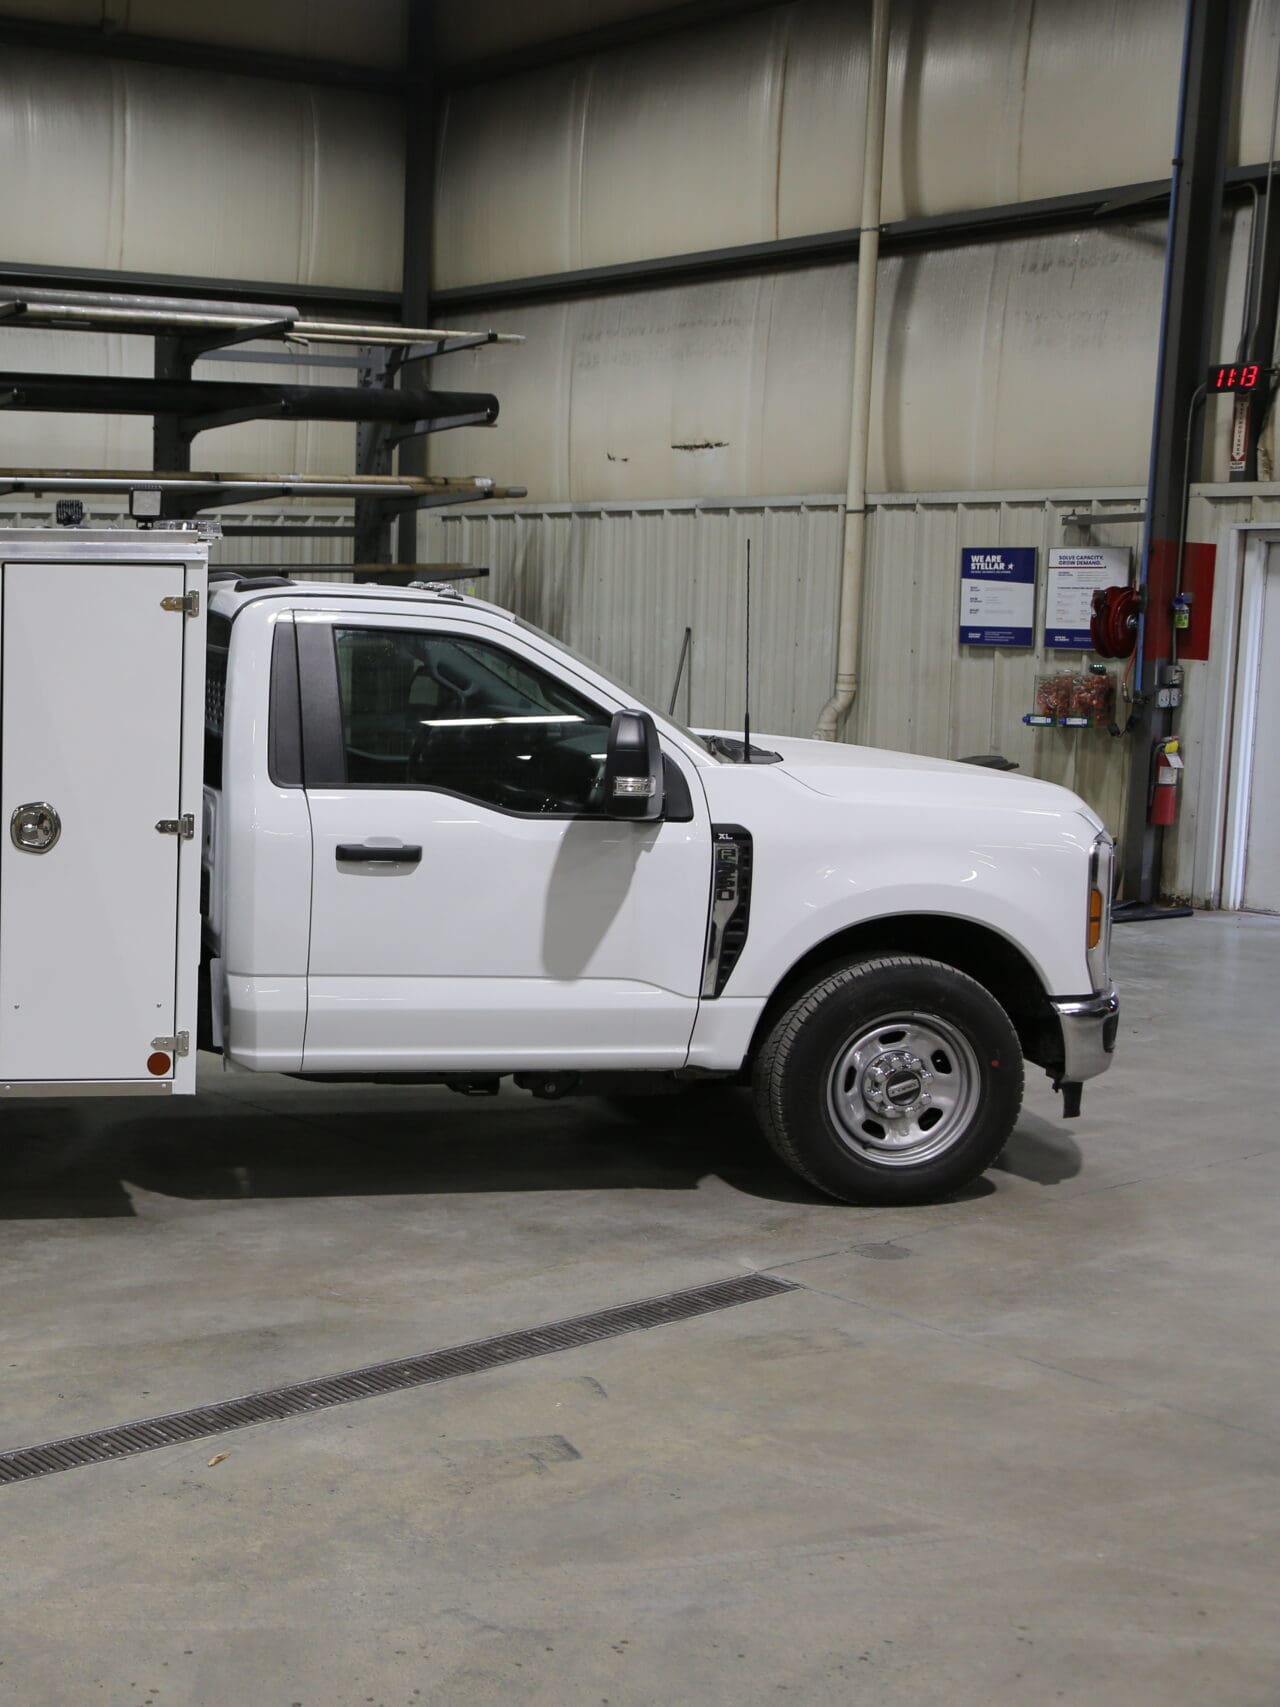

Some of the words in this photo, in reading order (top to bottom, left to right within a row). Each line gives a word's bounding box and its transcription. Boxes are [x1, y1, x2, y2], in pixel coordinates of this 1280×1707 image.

[1216, 366, 1259, 388] 11:13
[970, 555, 984, 563] WE
[985, 555, 1002, 563] ARE
[970, 562, 1005, 570] STELLAR
